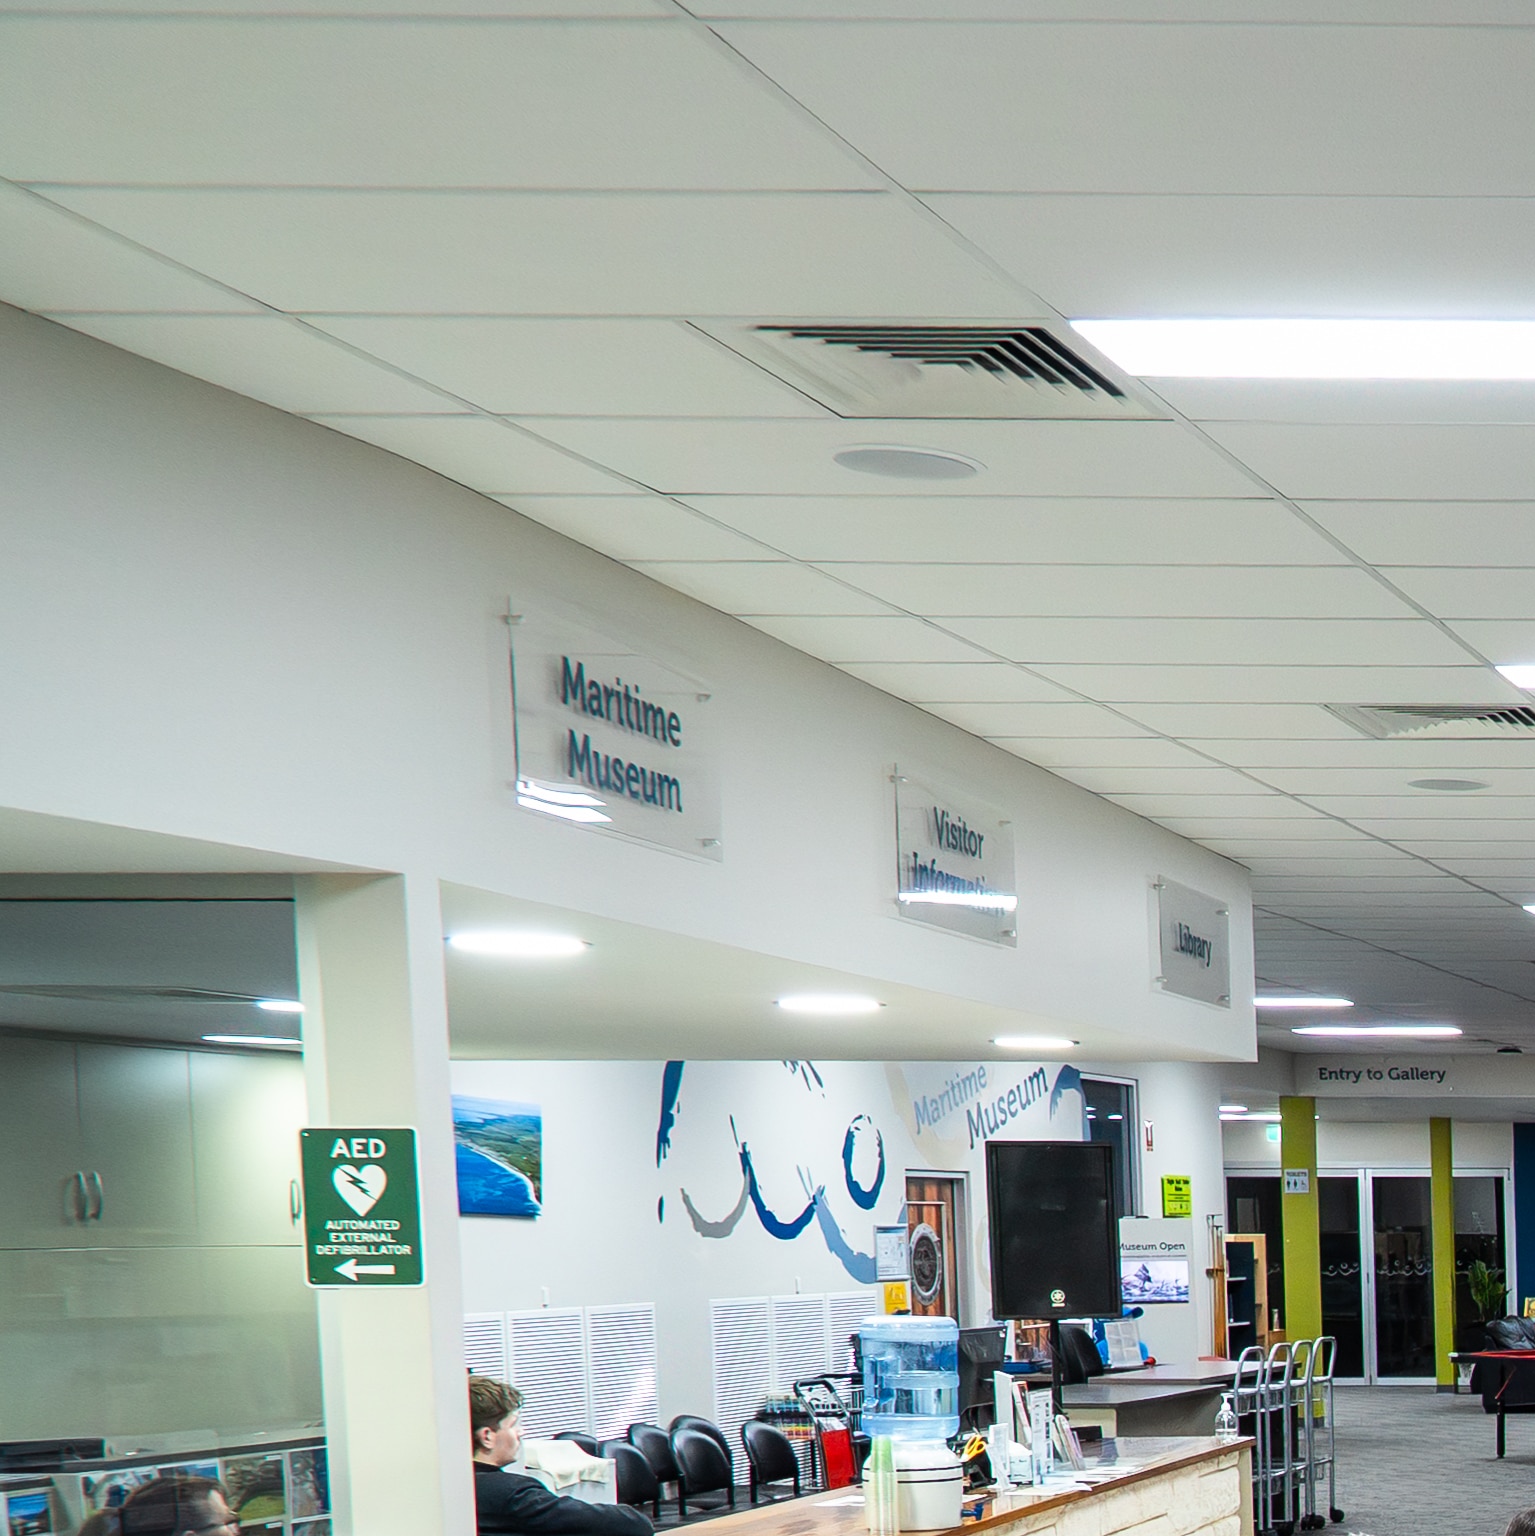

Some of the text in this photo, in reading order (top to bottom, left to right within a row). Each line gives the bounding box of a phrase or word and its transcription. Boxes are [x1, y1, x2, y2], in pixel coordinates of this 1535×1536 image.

[561, 655, 682, 747] Maritime
[567, 728, 683, 813] Museum
[933, 806, 984, 859] Visitor
[1178, 921, 1212, 968] Library
[1318, 1067, 1446, 1083] Entry to Gallery
[913, 1066, 987, 1135] Maritime
[966, 1066, 1048, 1150] Museum
[329, 1137, 387, 1158] AED
[324, 1219, 401, 1230] AUTOMATED
[328, 1232, 397, 1243] EXTERNAL
[314, 1244, 412, 1255] DEFIBRILLATOR
[1160, 1242, 1186, 1252] Open
